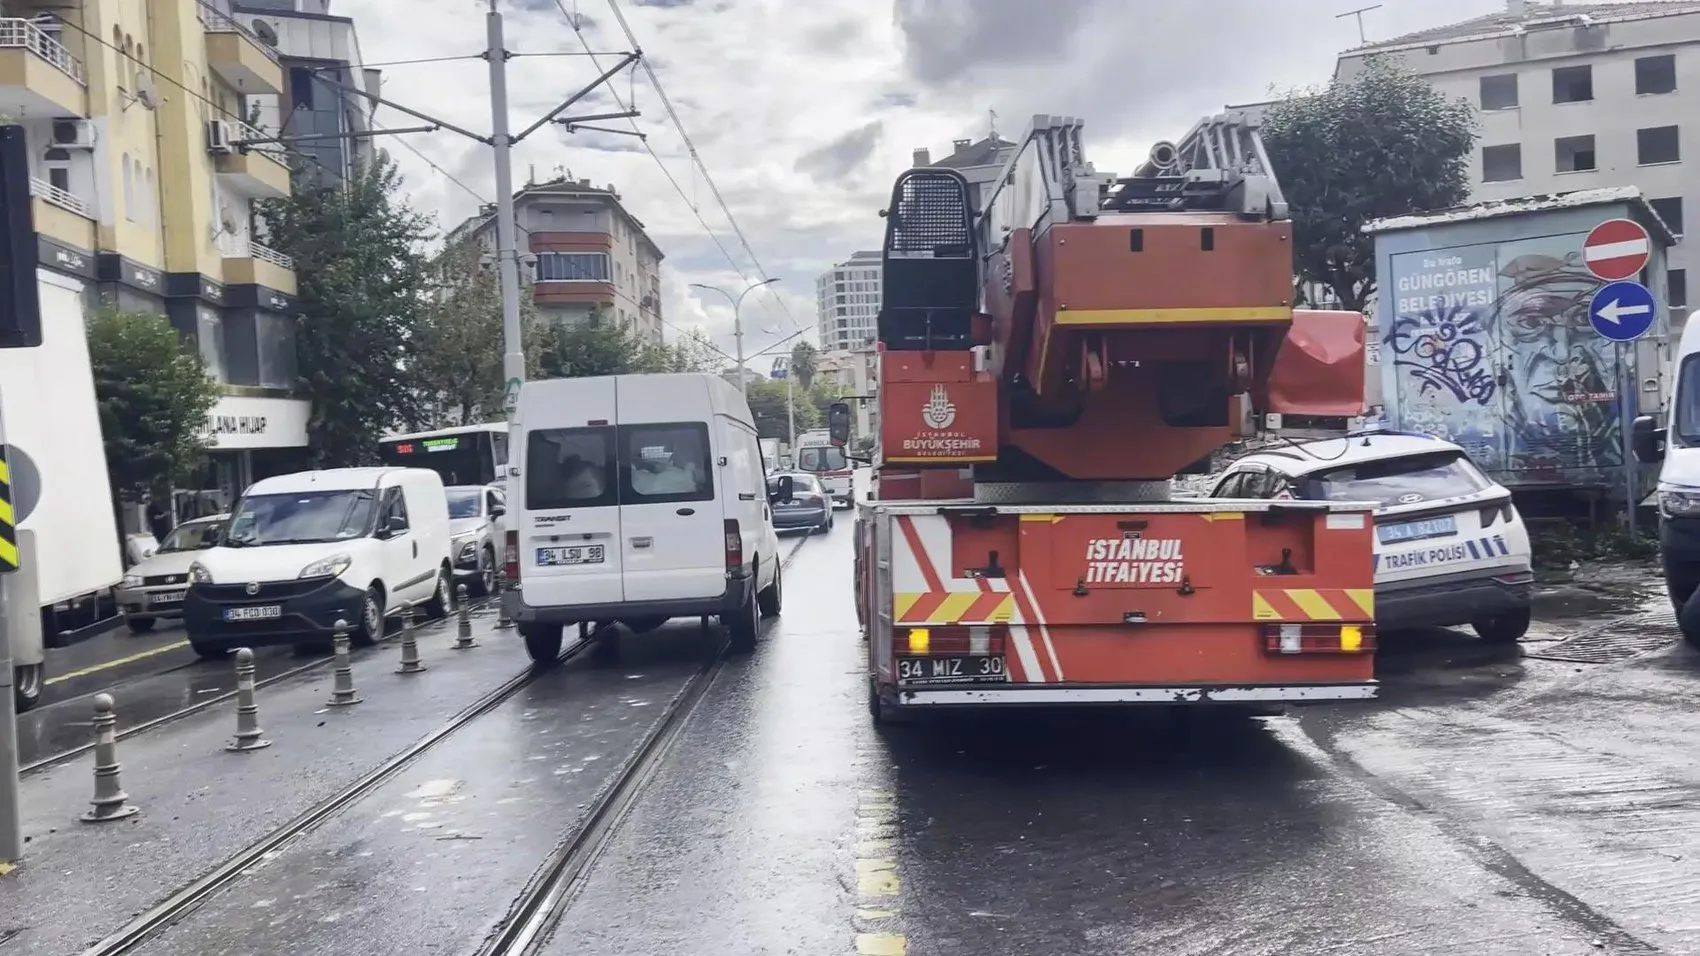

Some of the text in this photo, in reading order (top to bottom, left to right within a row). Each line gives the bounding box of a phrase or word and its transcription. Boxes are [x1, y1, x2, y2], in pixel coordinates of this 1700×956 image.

[1399, 267, 1491, 292] GÜNGÖREN
[1399, 286, 1493, 313] BELEDİYESİ
[903, 436, 981, 452] BÜYÜKŞEHİR
[544, 549, 556, 561] 34
[1384, 541, 1467, 569] TRAFİK POLİSİ
[900, 657, 1002, 678] 34 MIZ 30
